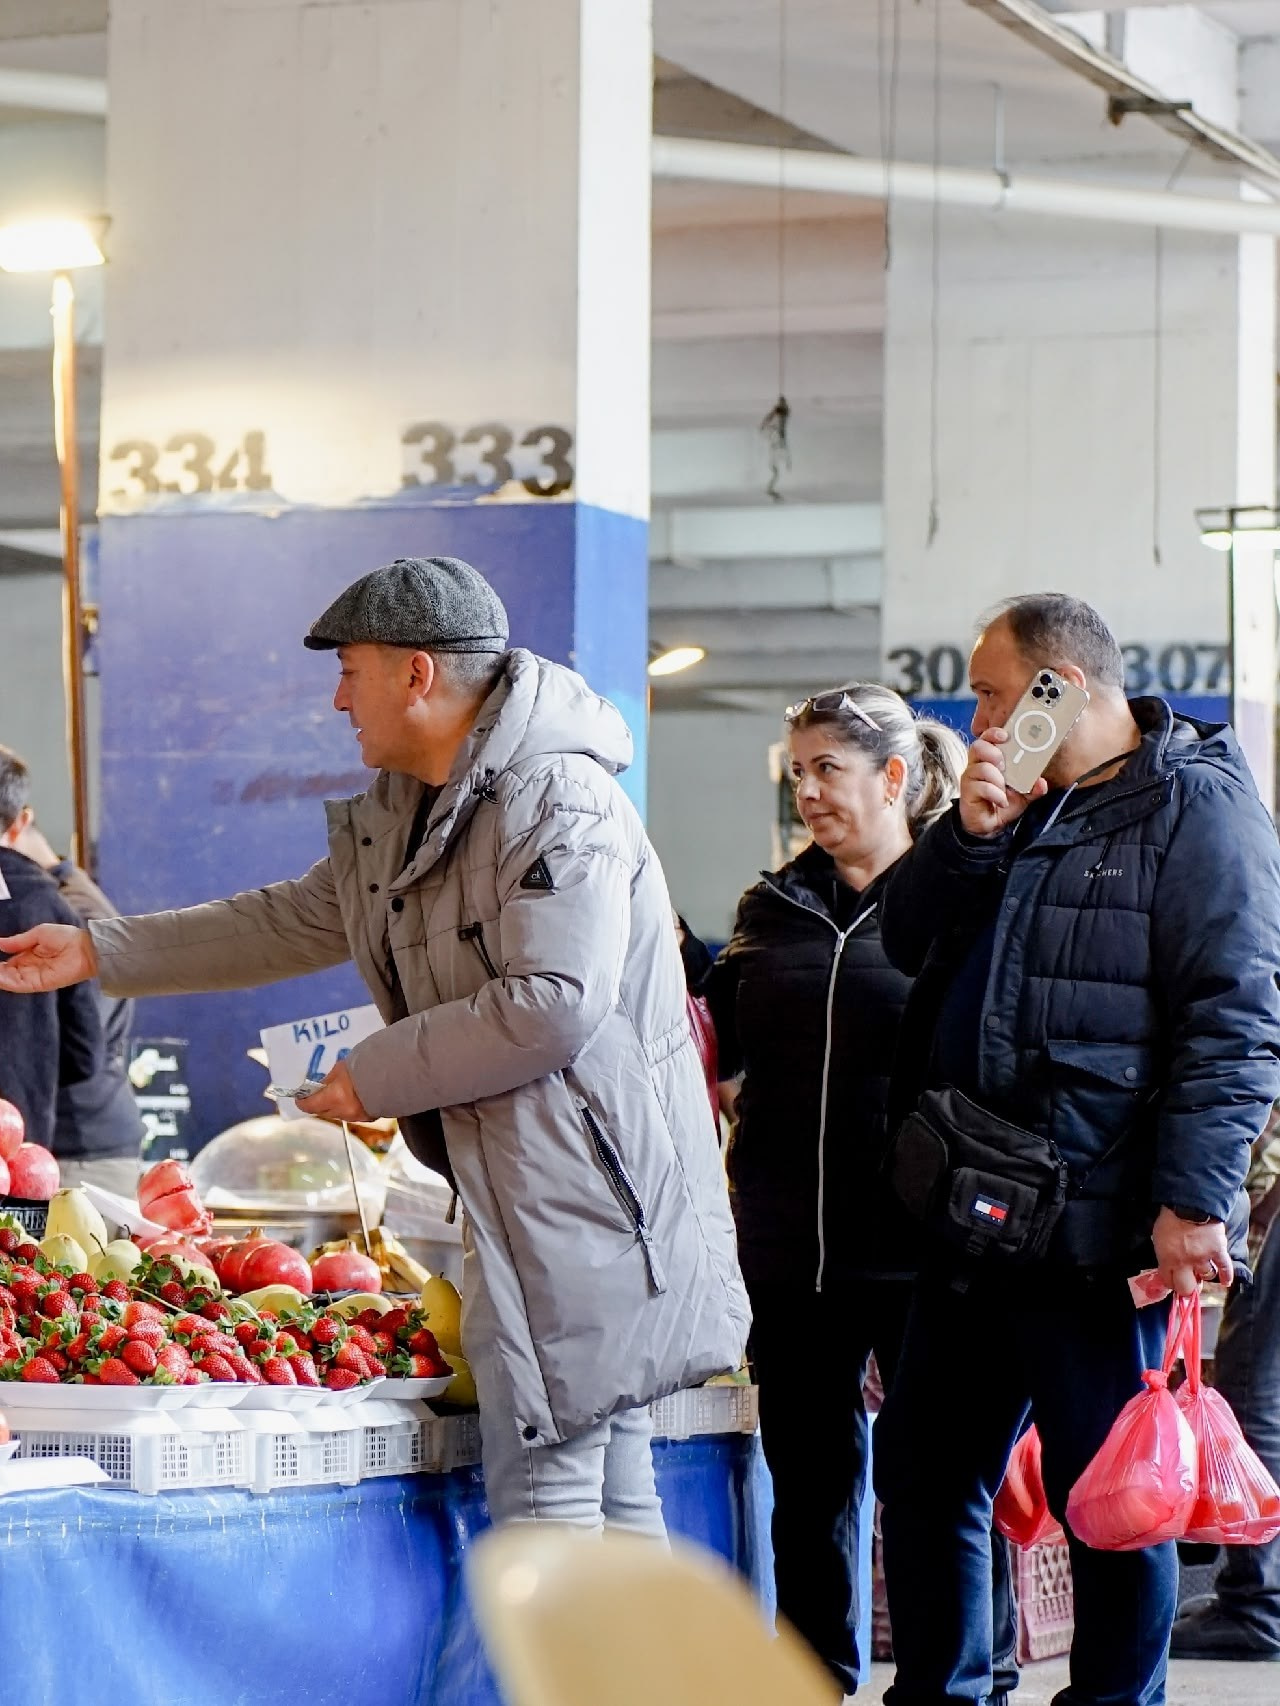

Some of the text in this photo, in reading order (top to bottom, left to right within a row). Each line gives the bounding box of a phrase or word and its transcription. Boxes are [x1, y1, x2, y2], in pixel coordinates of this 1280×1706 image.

[109, 428, 272, 496] 334
[400, 421, 574, 496] 333
[887, 645, 964, 696] 30
[1120, 643, 1231, 692] 307
[531, 871, 540, 880] ck
